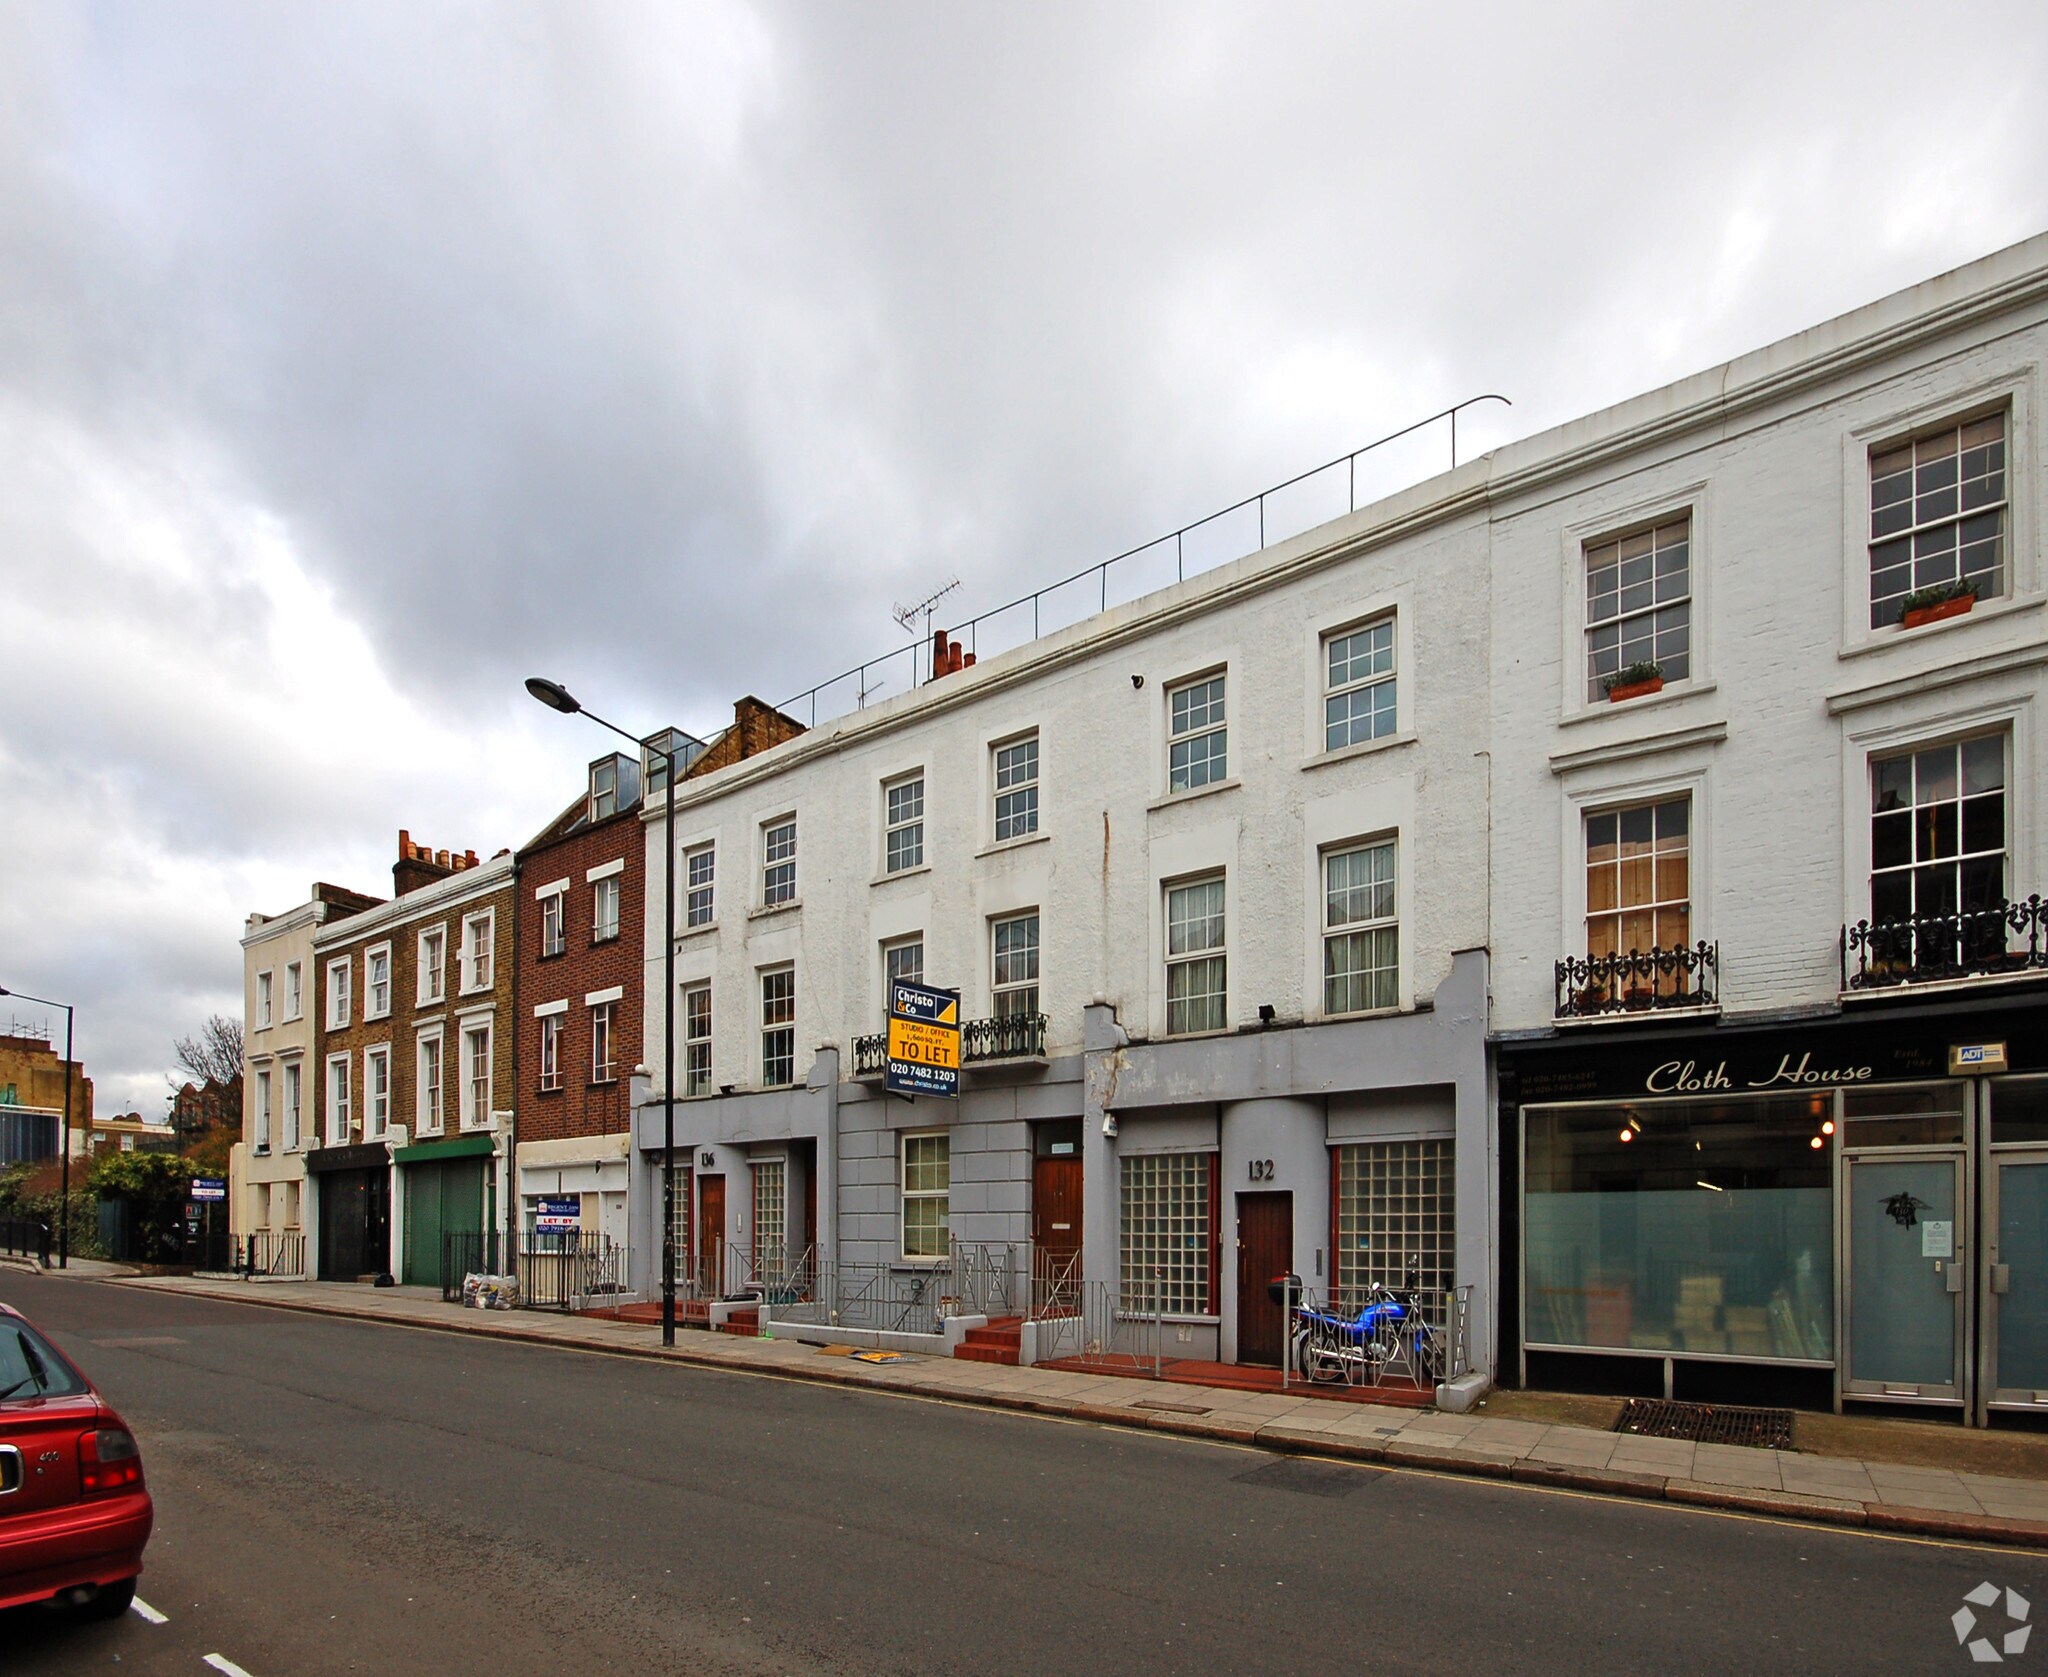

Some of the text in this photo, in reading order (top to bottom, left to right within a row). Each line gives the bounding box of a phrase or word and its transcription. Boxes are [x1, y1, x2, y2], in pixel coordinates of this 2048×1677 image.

[897, 989, 934, 1008] Christo
[900, 1022, 924, 1033] STUDIO
[930, 1028, 950, 1038] OFFICE
[899, 1041, 950, 1064] TO LET
[1962, 1049, 1982, 1060] ADT
[891, 1062, 956, 1083] 020 7482 1203
[1646, 1051, 1872, 1093] Cloth House
[701, 1152, 715, 1167] 136
[1248, 1158, 1274, 1181] 132
[39, 1450, 60, 1462] 400
